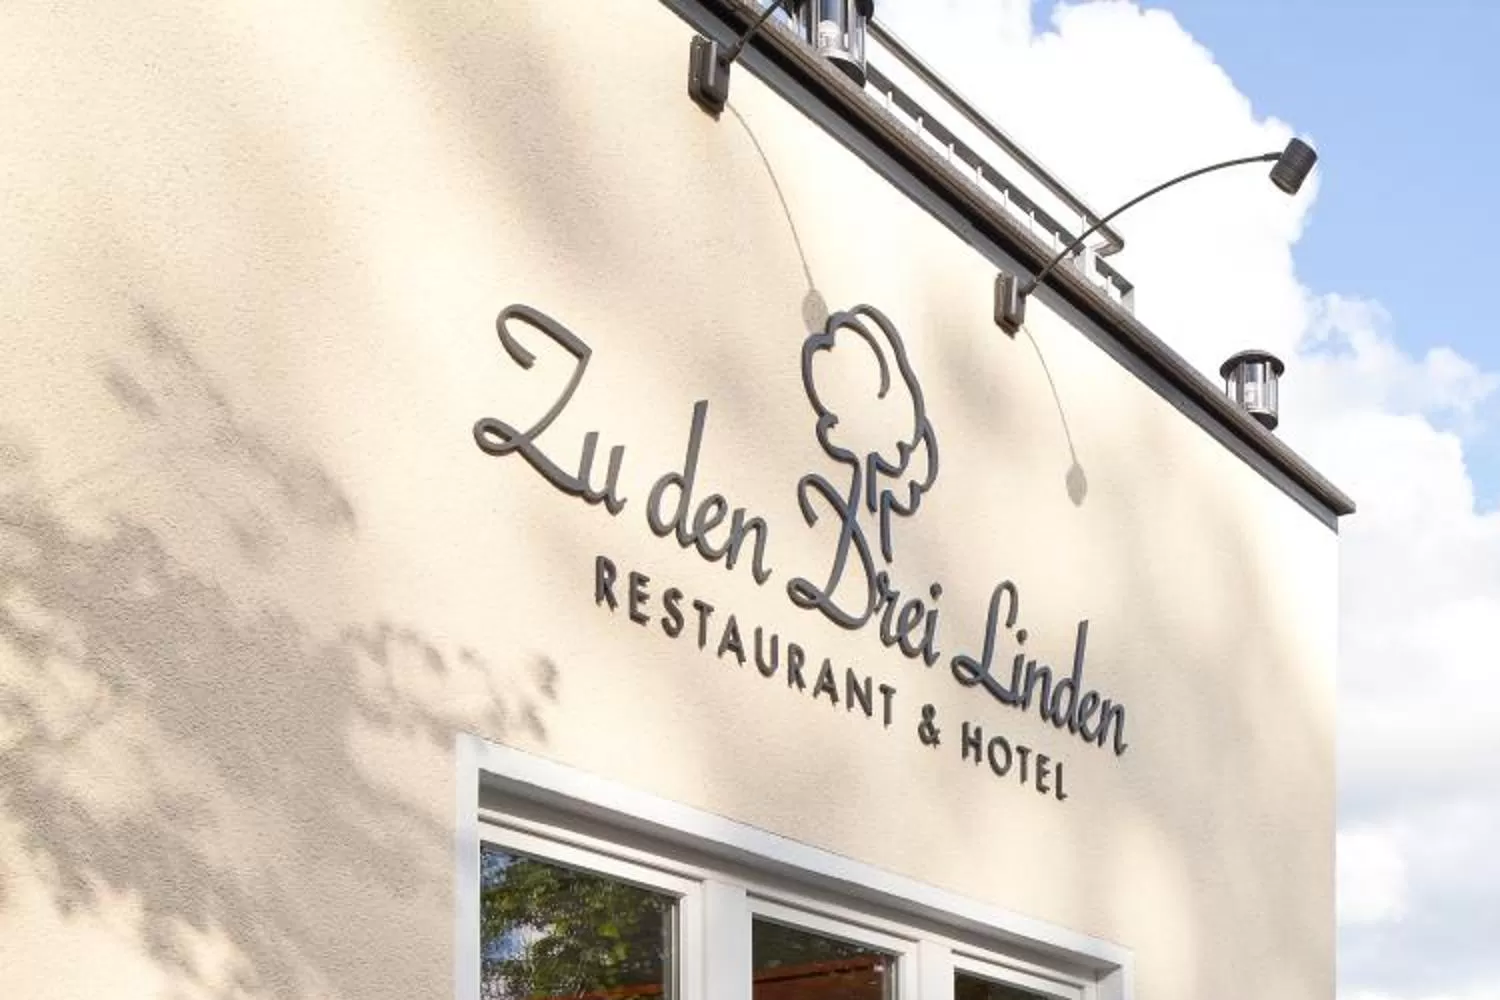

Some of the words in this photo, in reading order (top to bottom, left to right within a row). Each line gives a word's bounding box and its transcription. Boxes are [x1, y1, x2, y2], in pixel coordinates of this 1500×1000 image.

[473, 303, 628, 516] Zu
[646, 399, 773, 585] den
[787, 462, 942, 667] Drei
[951, 580, 1129, 757] Linden
[594, 555, 898, 727] RESTAURANT
[918, 702, 942, 748] &
[960, 720, 1069, 802] HOTEL
